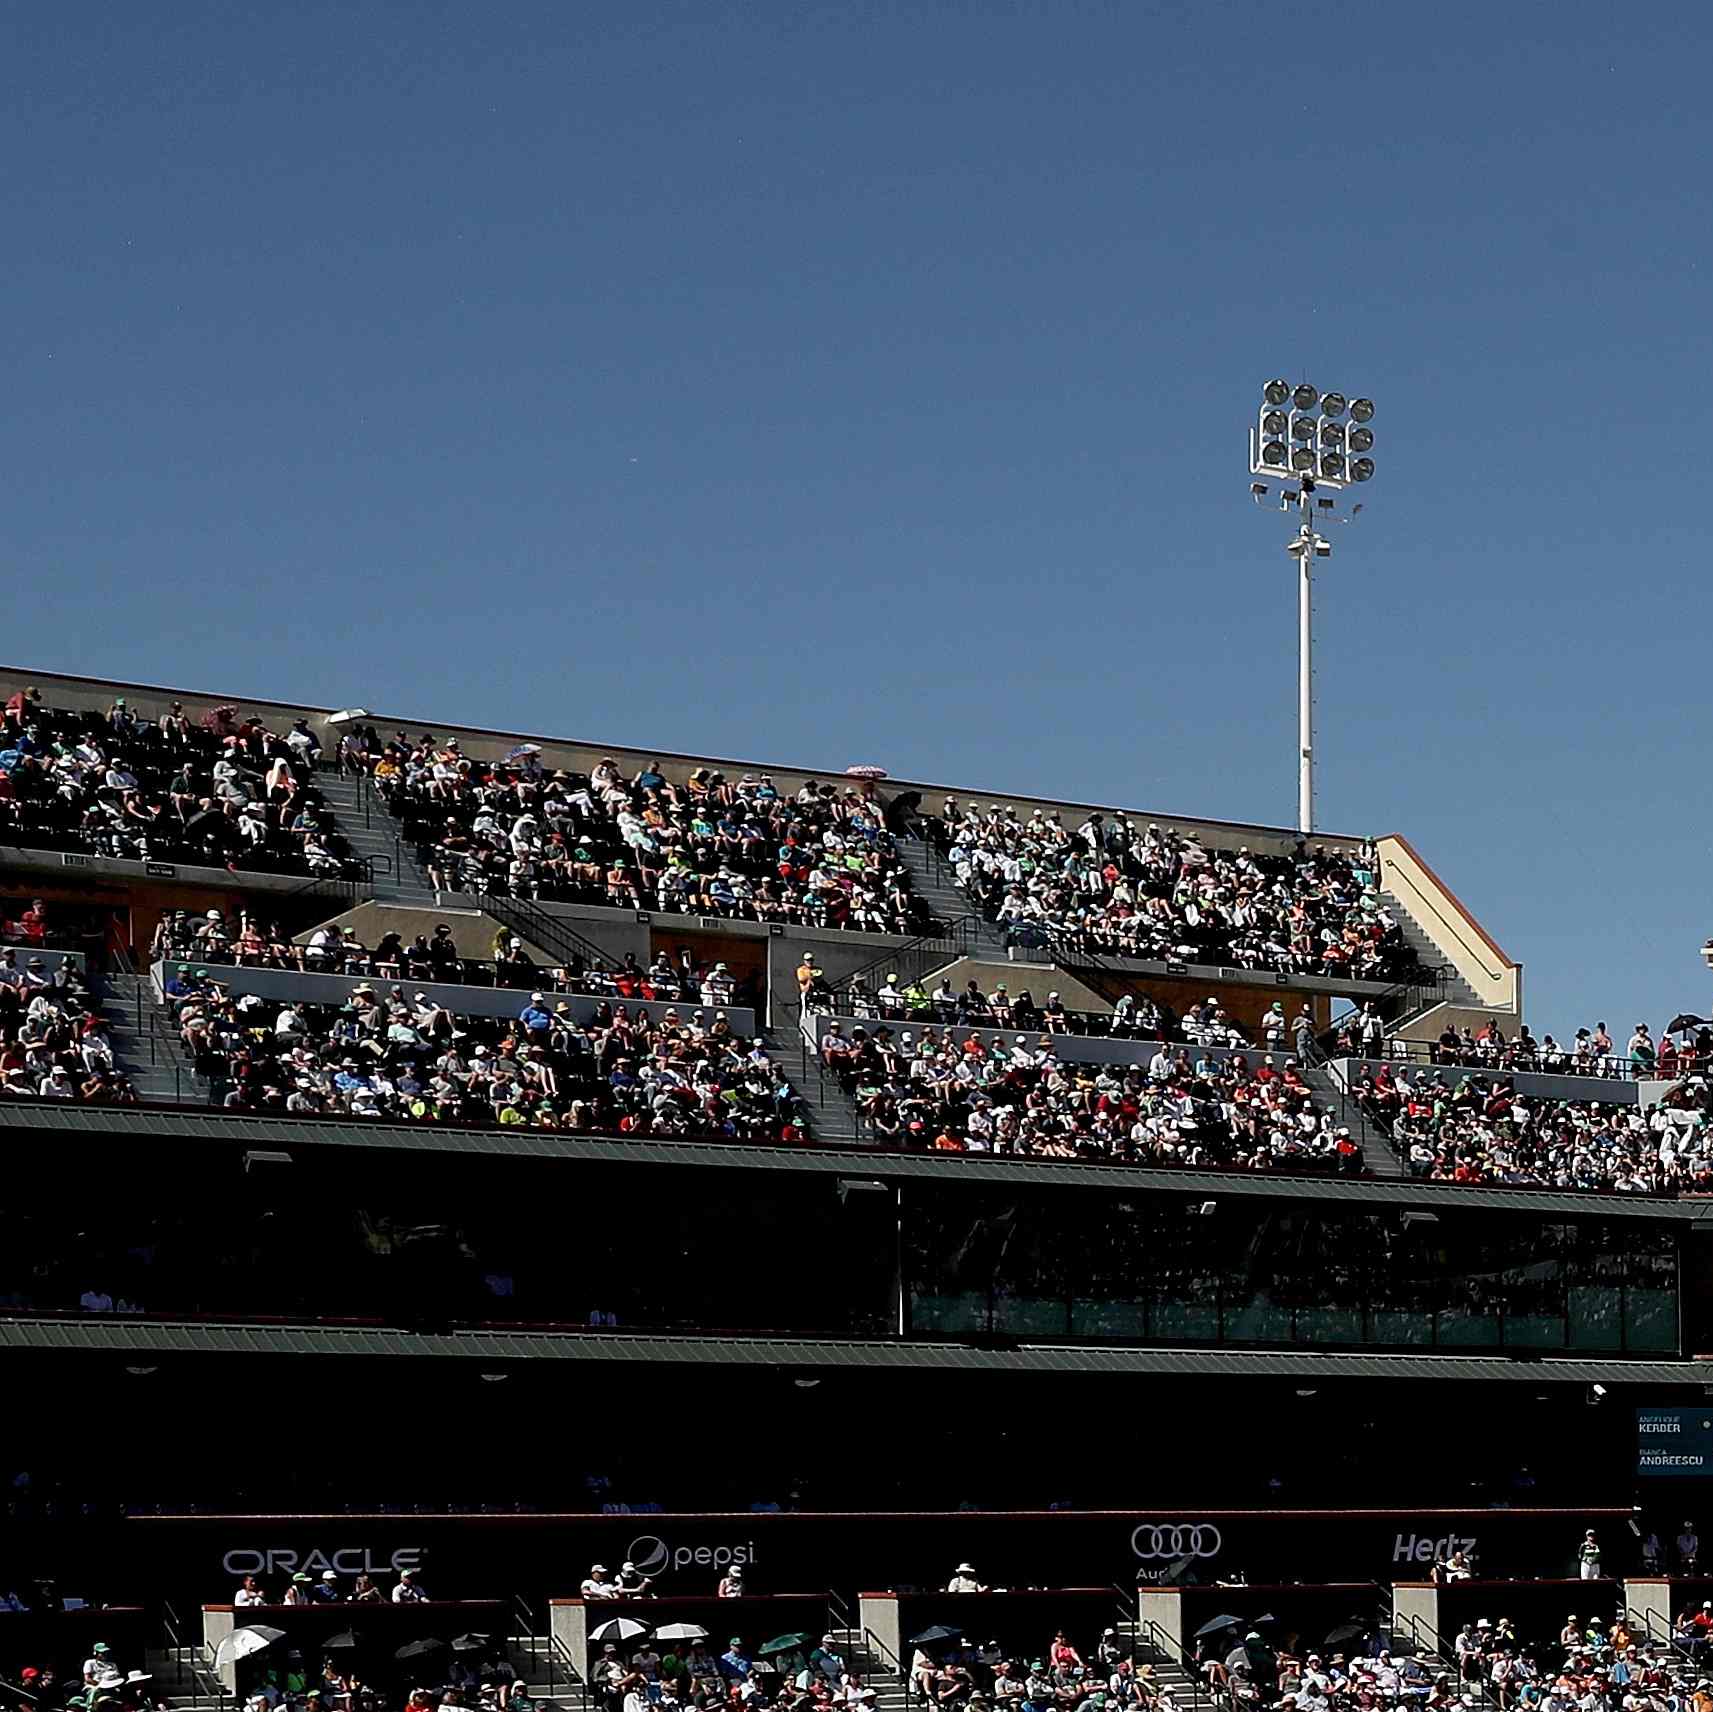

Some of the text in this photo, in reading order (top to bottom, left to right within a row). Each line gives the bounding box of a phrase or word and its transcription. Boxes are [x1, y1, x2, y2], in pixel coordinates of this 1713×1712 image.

[1639, 1424, 1681, 1433] KERBER
[1639, 1456, 1703, 1465] ANDREESCU
[674, 1541, 754, 1571] pepsi
[1391, 1533, 1477, 1562] Hertz
[223, 1548, 422, 1575] ORACLE
